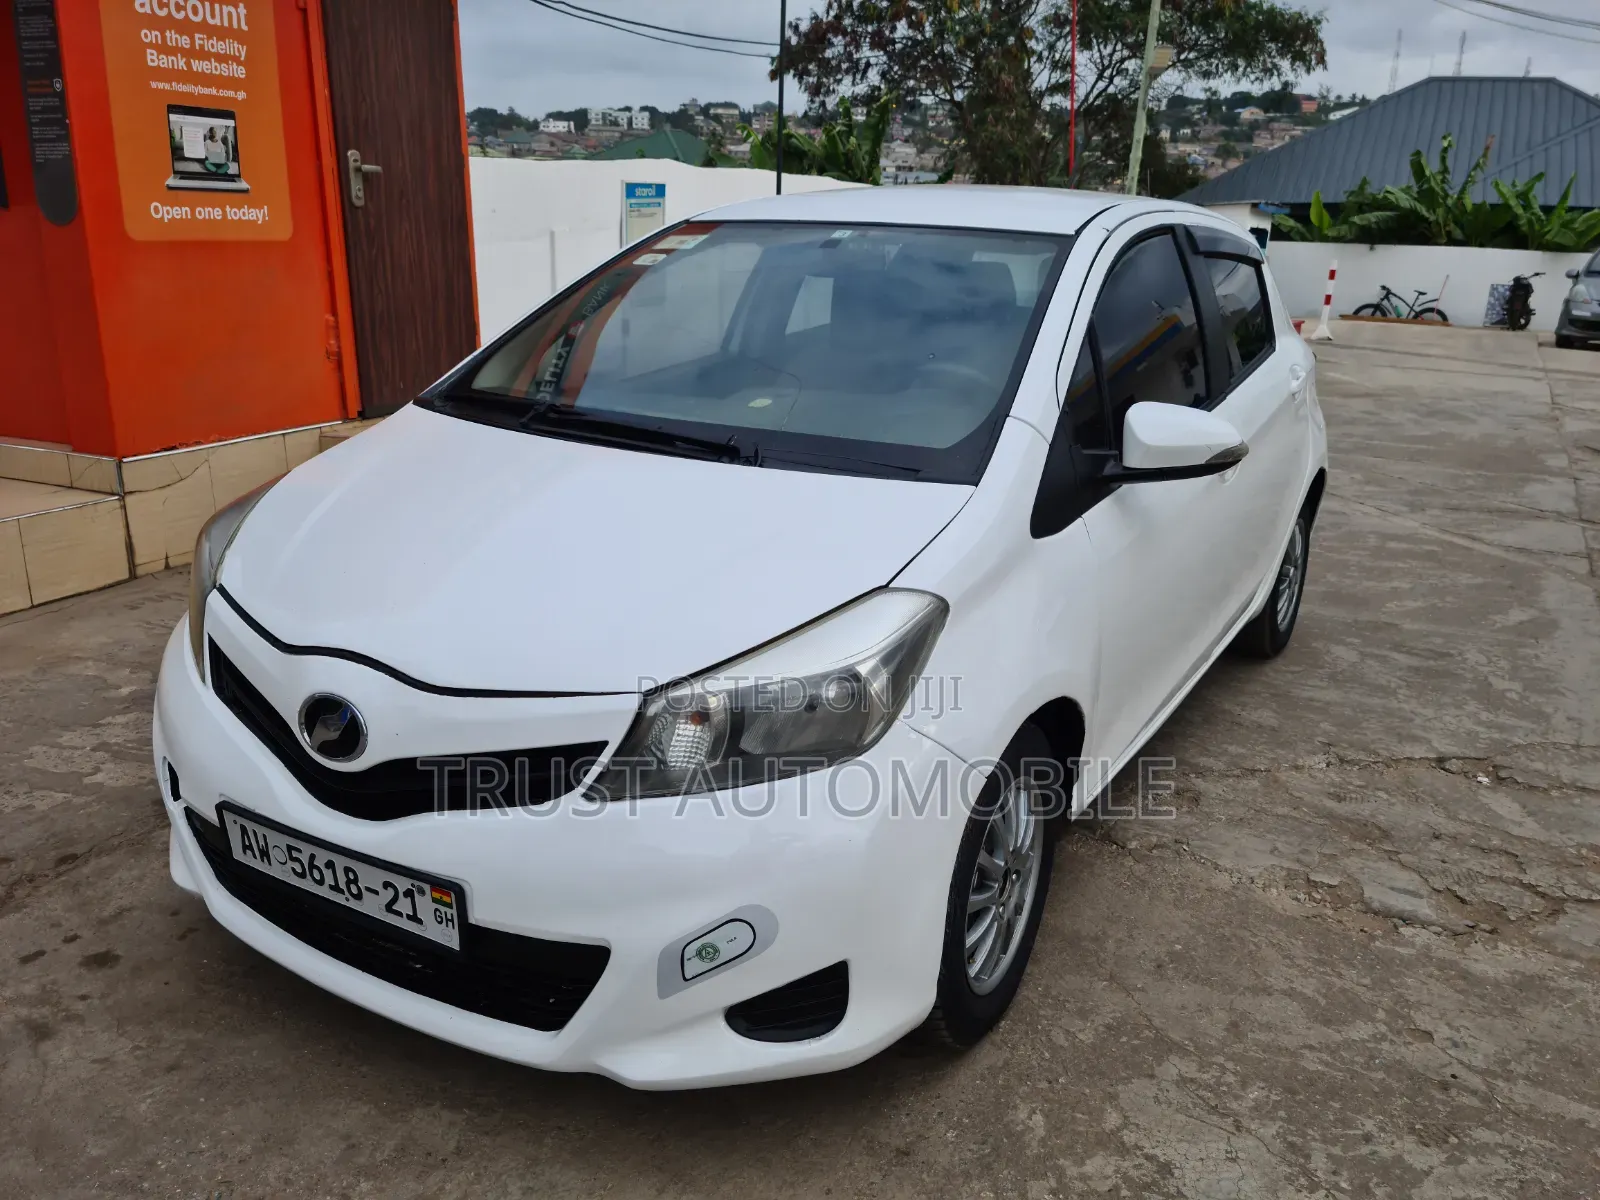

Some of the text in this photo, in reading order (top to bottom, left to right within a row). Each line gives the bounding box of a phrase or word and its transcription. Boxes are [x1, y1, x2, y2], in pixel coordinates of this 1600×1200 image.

[134, 0, 248, 31] account
[141, 28, 247, 60] on the Fidelity
[146, 48, 246, 78] Bank website
[150, 80, 247, 100] www.fidelitybank.com.gh
[150, 201, 269, 224] Open one today!
[240, 824, 424, 925] AW 5618-21
[433, 908, 455, 930] GH
